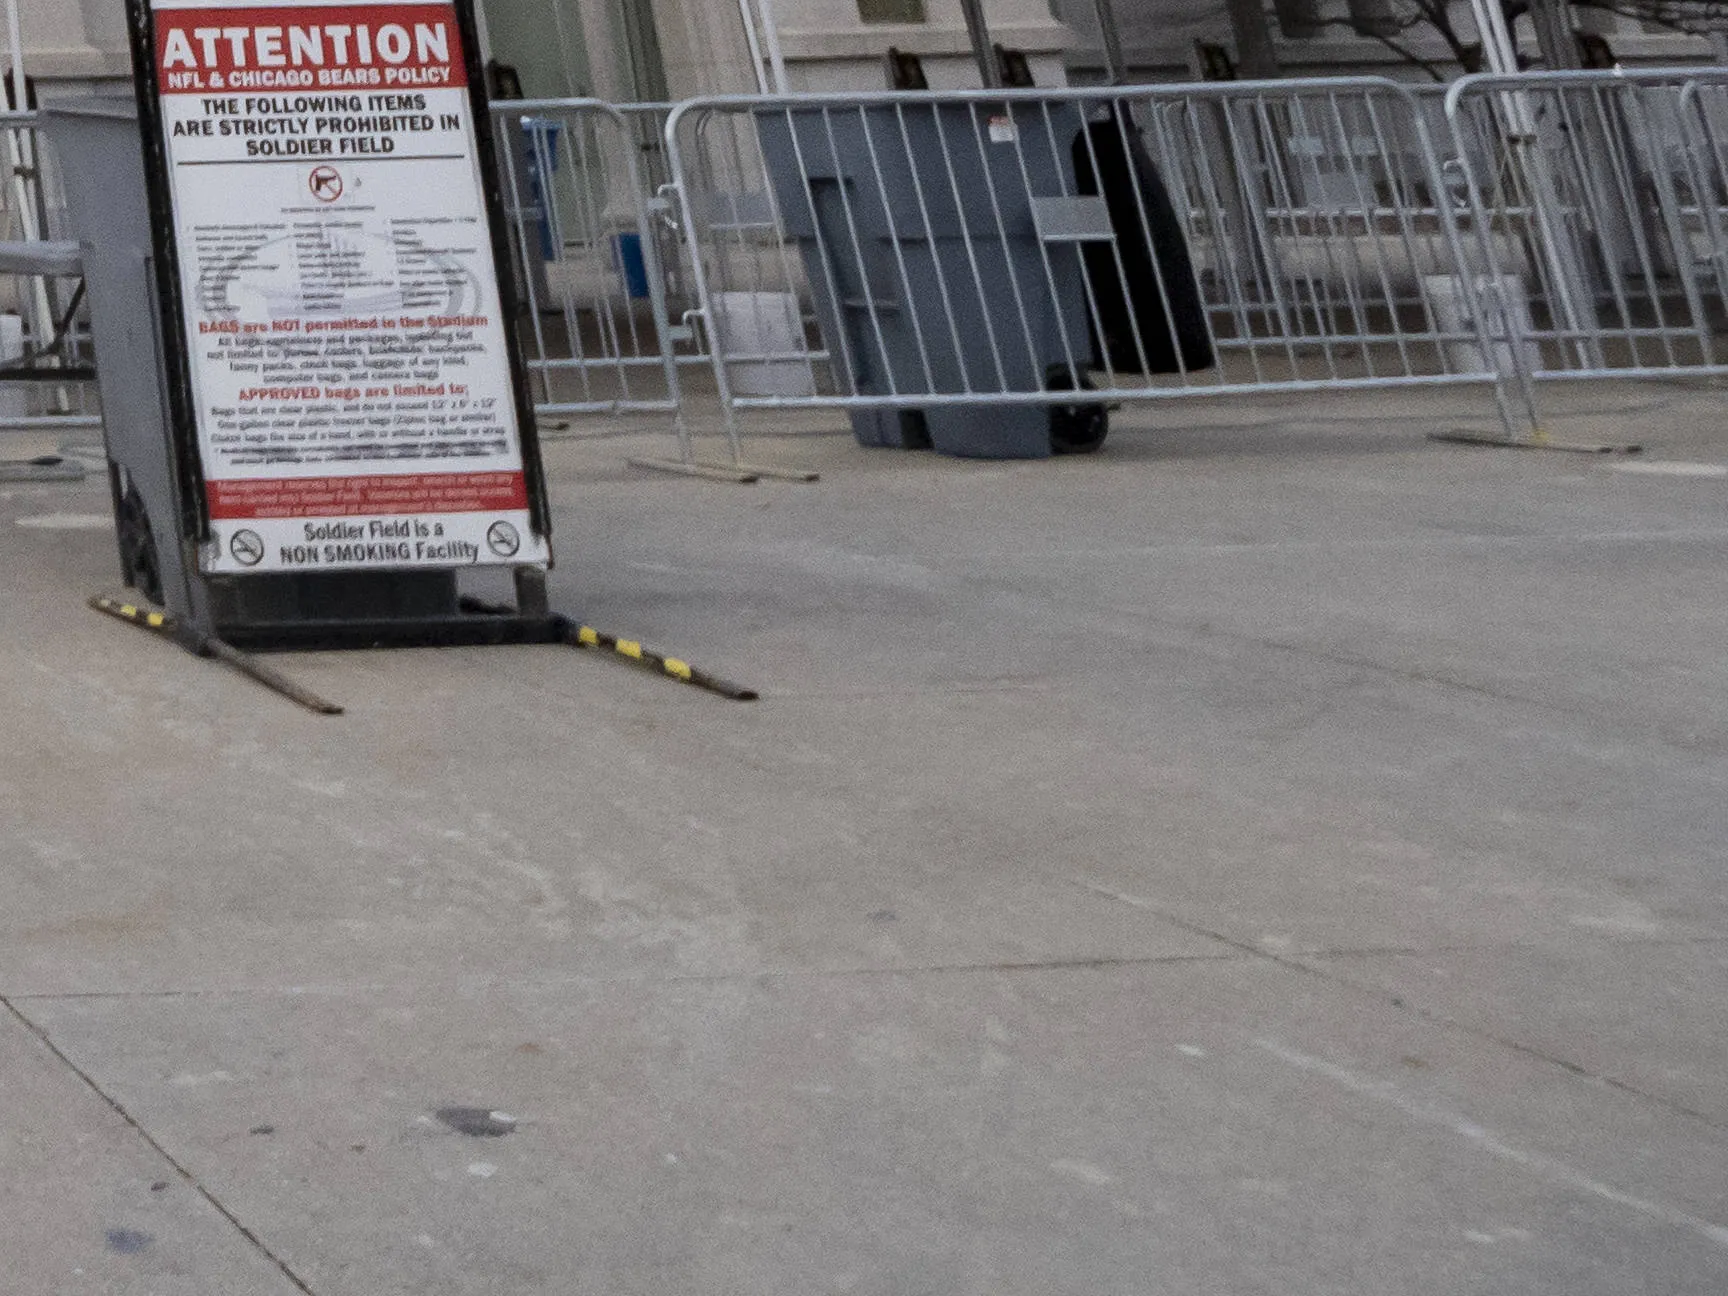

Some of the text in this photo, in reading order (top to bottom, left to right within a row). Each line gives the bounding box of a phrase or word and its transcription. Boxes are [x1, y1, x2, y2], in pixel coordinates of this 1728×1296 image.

[163, 23, 450, 68] ATTENTION
[168, 67, 450, 89] NFL & CHICAGO BEARS POLICY
[201, 94, 426, 115] THE FOLLOWING ITEMS
[173, 114, 460, 137] ARE STRICTLY PROHIBITED IN
[246, 137, 394, 156] SOLDIER FIELD
[199, 315, 488, 334] BAGS are NOT permitted in the Stadium
[239, 384, 444, 401] APPROVED bags are limited
[304, 520, 443, 541] Soldier Field is a
[281, 542, 479, 563] NON SMOKING Facility
